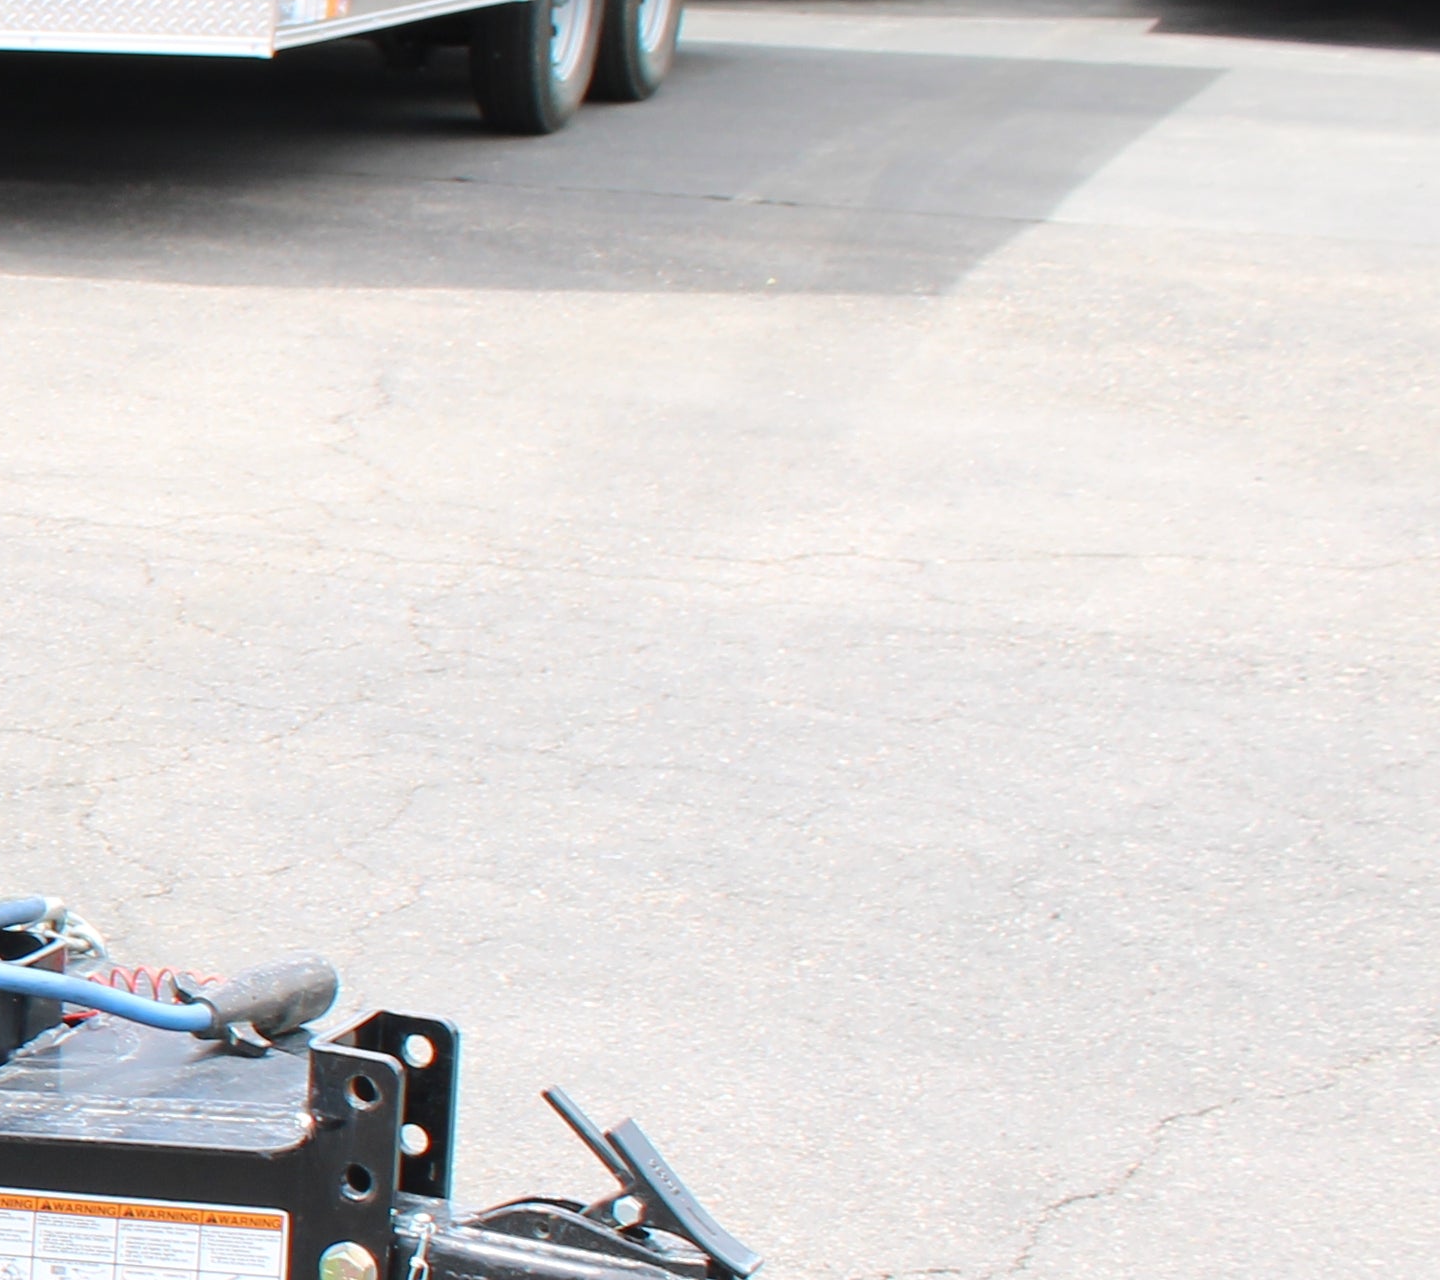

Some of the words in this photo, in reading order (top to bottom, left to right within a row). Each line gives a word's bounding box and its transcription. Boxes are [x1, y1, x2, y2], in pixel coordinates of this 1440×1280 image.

[52, 1201, 117, 1216] WARNING
[135, 1208, 199, 1222] WARNING
[219, 1214, 281, 1228] WARNING
